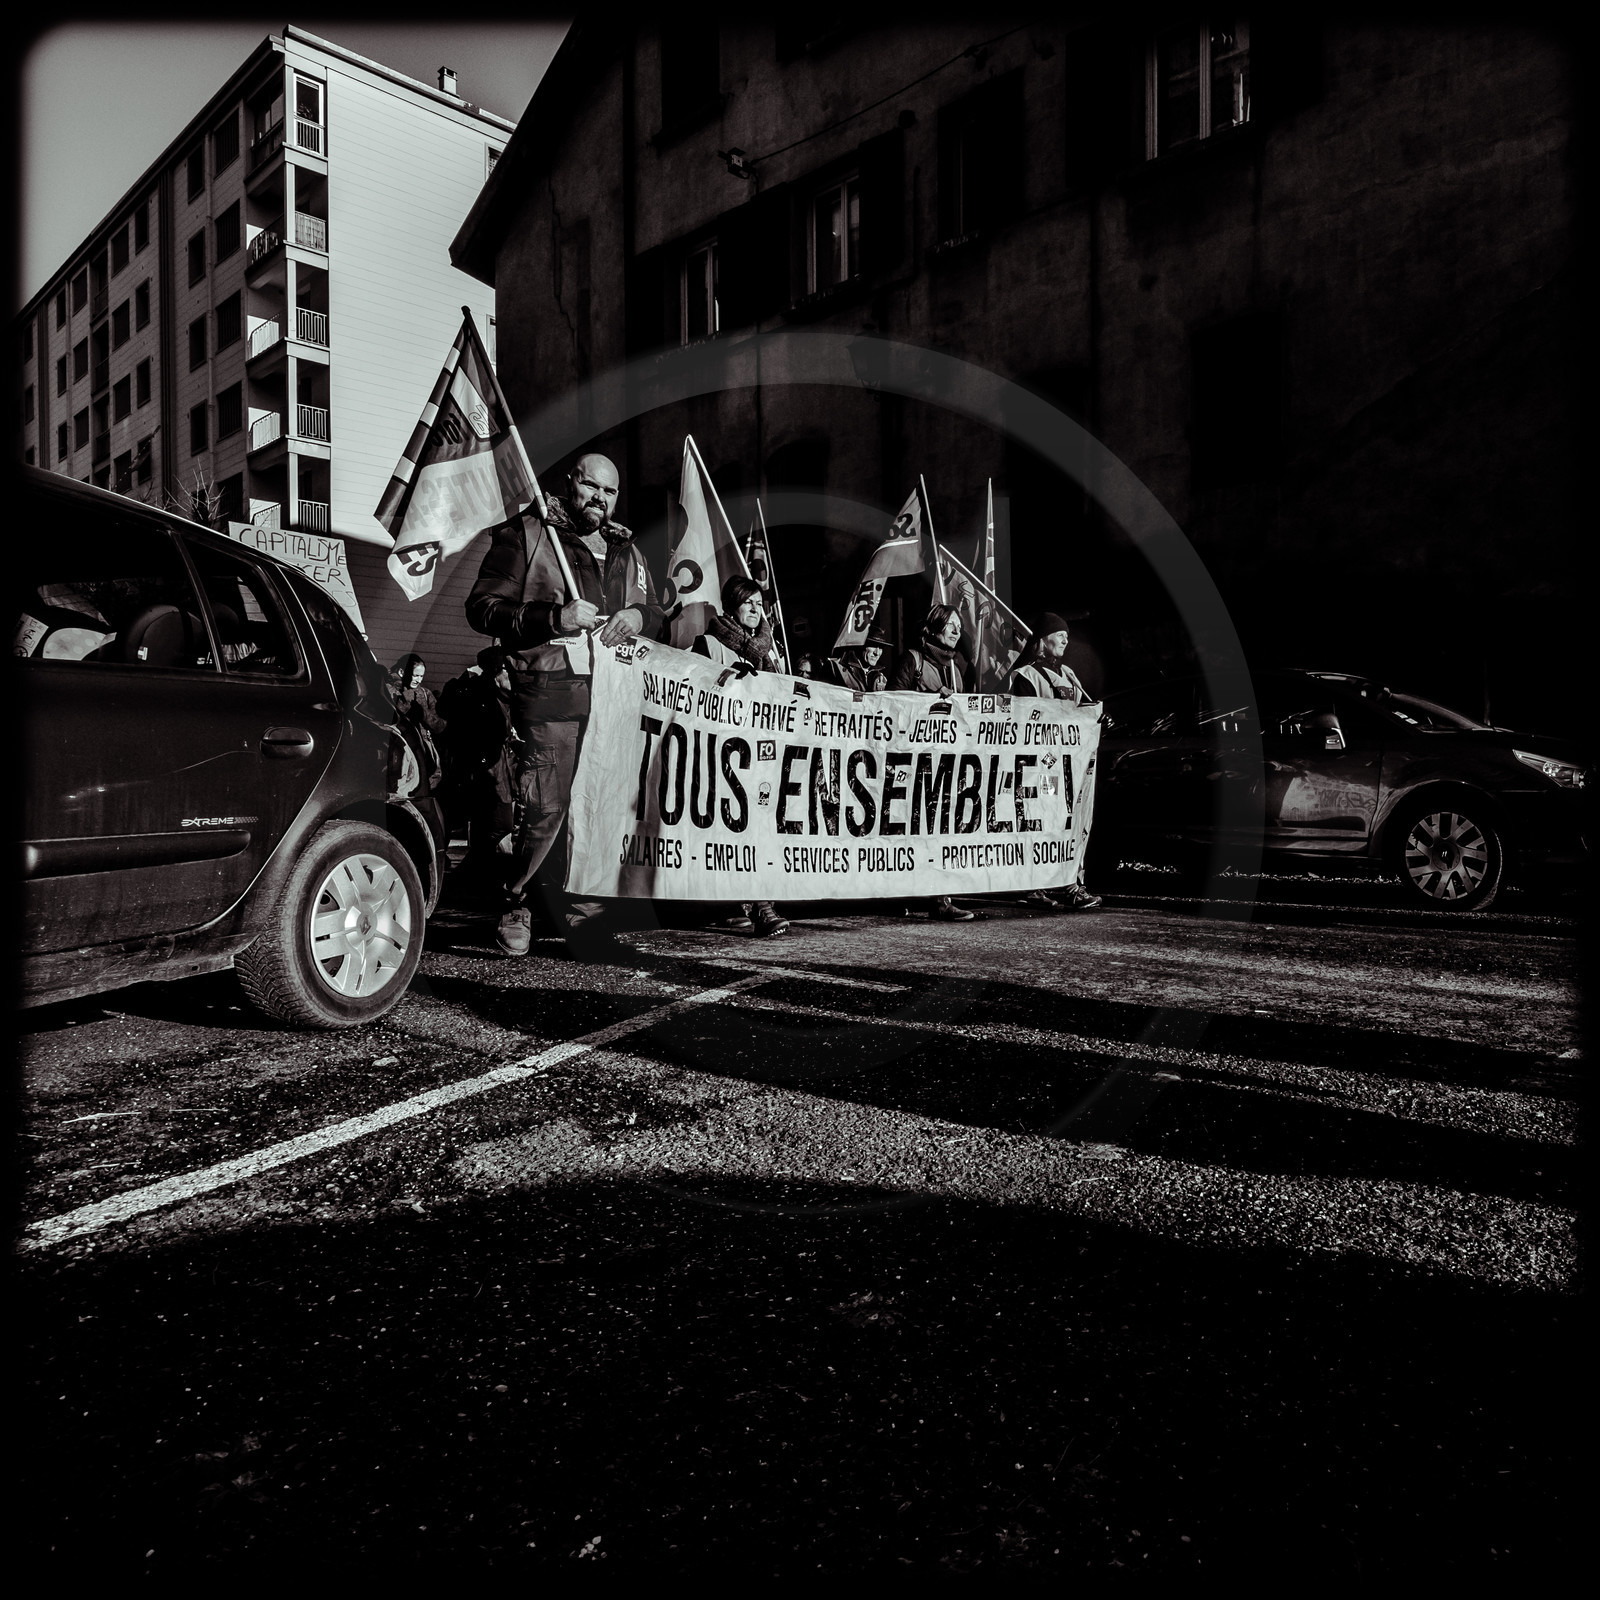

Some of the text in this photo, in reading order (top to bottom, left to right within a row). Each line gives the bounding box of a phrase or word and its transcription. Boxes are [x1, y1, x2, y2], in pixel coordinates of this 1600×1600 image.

[615, 643, 635, 657] cgt
[643, 671, 694, 715] SALARIÉS
[814, 710, 893, 742] RETRAITÉS
[909, 719, 957, 744] JEUNES
[977, 718, 1018, 745] PRIVÉS
[1024, 724, 1081, 746] D'EMPLOI
[760, 743, 774, 755] FO
[635, 714, 751, 834] TOUS
[776, 744, 1043, 838] ENSEMBLE
[181, 817, 234, 827] EXTREME
[619, 833, 683, 869] SALAIRES
[705, 842, 757, 872] EMPLOI
[784, 846, 850, 873] SERVICES
[858, 846, 915, 873] PUBLICS
[942, 842, 1025, 870] PROTECTION
[1033, 838, 1075, 864] SOCIALE
